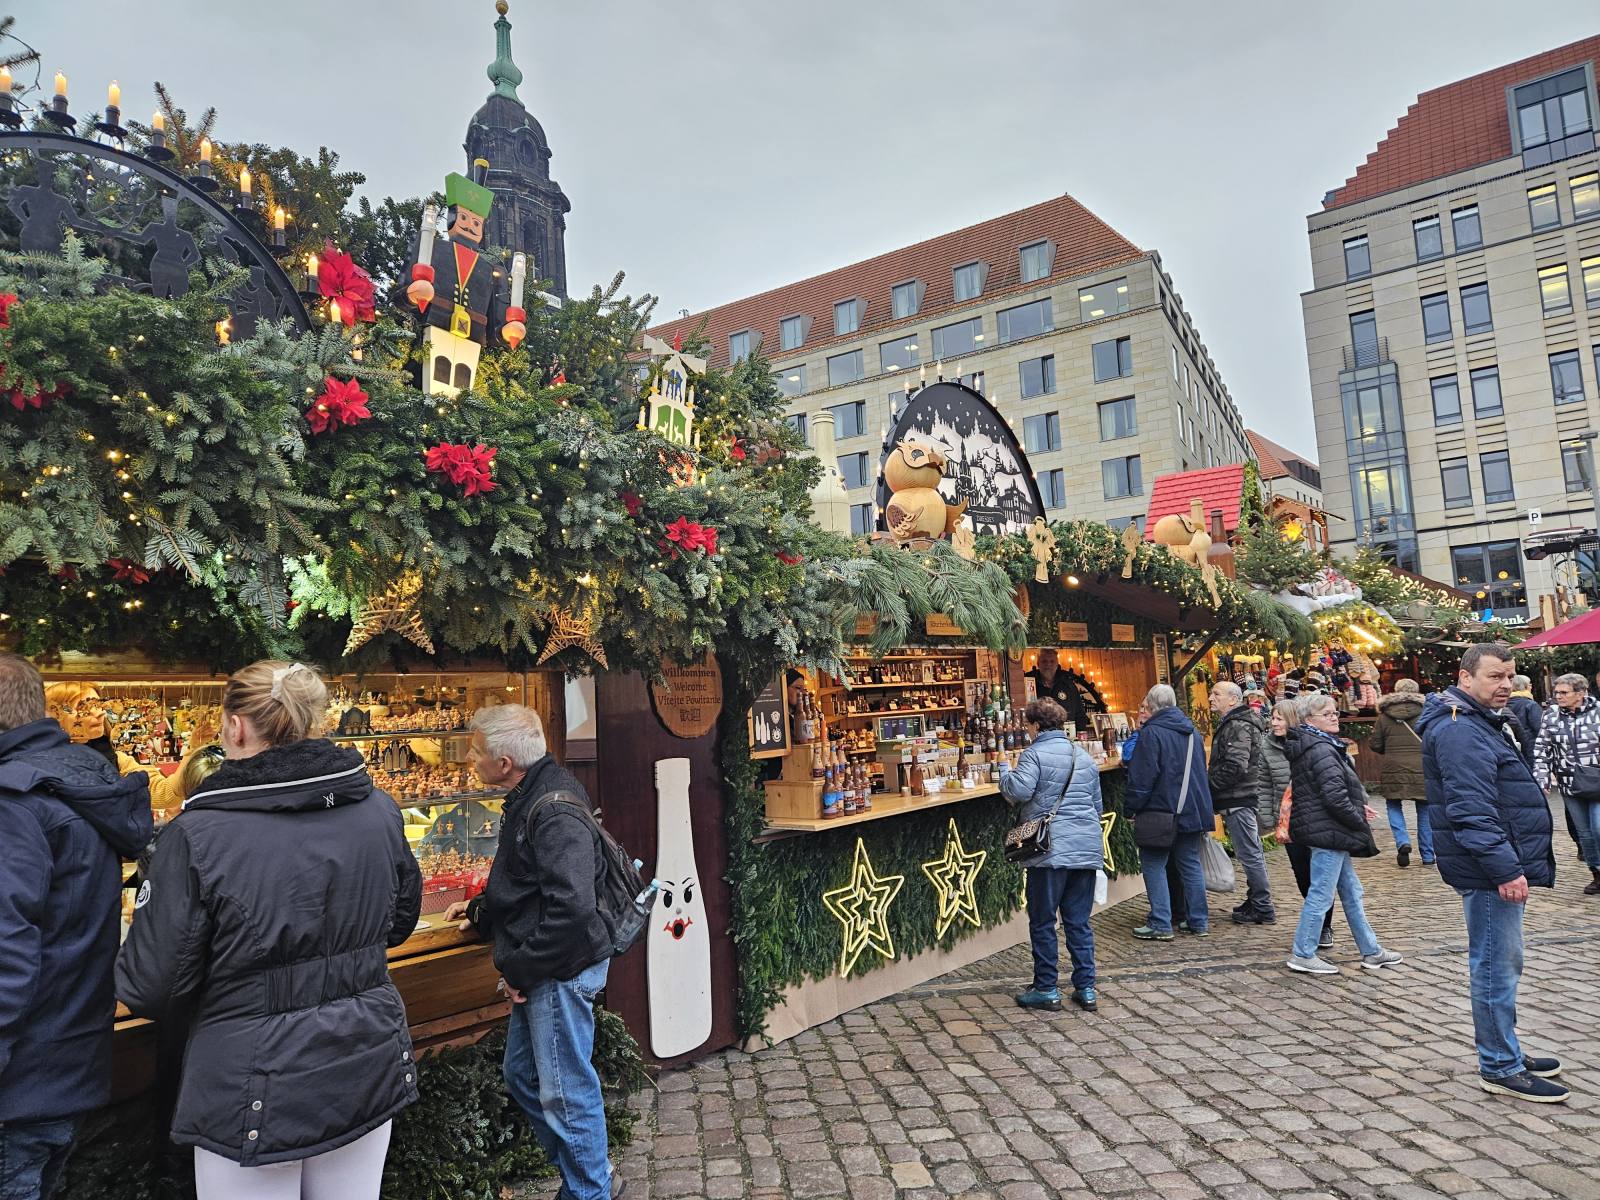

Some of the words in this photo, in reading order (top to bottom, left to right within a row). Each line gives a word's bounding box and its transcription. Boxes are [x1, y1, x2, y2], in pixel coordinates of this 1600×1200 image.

[1531, 513, 1539, 522] P
[663, 667, 716, 678] Willkommen
[674, 681, 707, 692] Welcome
